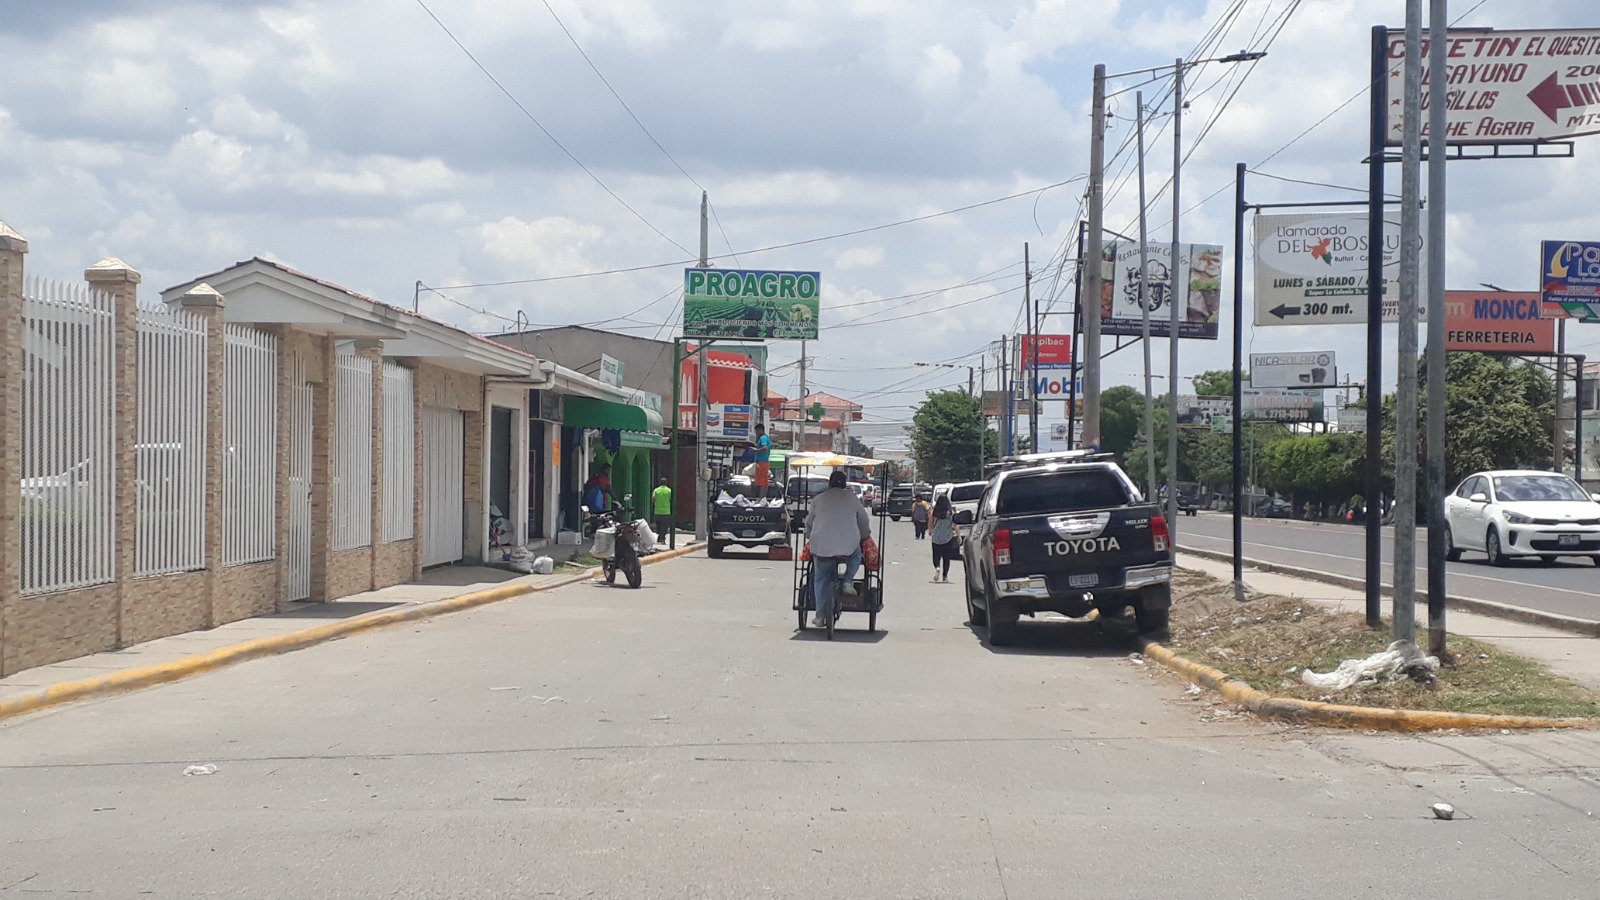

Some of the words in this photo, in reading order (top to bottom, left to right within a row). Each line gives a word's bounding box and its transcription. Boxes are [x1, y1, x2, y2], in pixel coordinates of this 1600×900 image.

[1523, 36, 1547, 56] EL
[1475, 116, 1535, 136] AGRIA
[1277, 224, 1347, 237] Llamarada
[1277, 239, 1311, 254] DEL
[688, 270, 818, 300] PROAGRO
[1273, 278, 1304, 288] LUNES
[1315, 274, 1356, 287] SÁBADO
[1302, 302, 1328, 316] 300
[1448, 331, 1536, 343] FERRETERIA
[1254, 355, 1316, 367] NICASOLAR
[1044, 537, 1121, 556] TOYOTA
